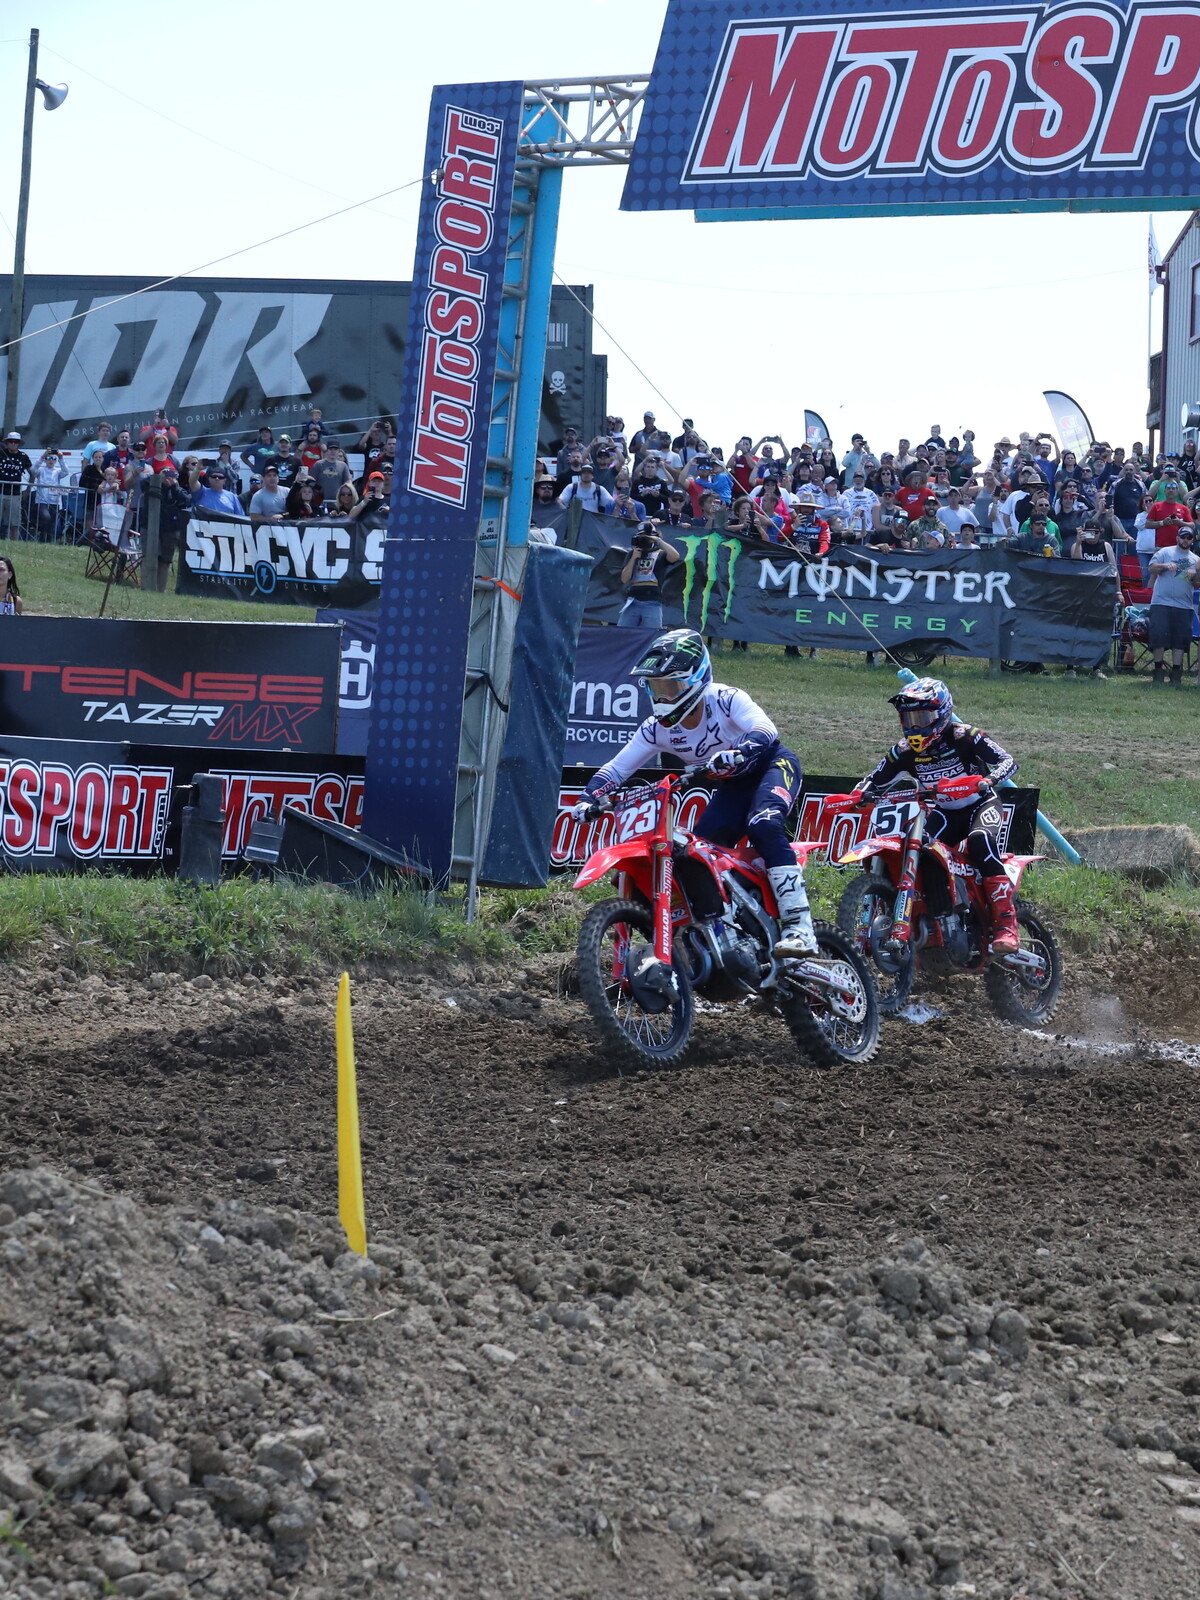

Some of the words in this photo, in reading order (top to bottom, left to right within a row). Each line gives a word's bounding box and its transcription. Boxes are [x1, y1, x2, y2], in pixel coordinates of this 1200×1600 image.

[186, 409, 244, 424] ORIGINAL
[250, 402, 315, 416] RACEWEAR
[185, 519, 351, 580] STACYC
[199, 575, 248, 586] STABILITY
[284, 583, 328, 593] CYCLE
[758, 557, 1017, 610] MONSTER
[796, 609, 979, 634] ENERGY
[82, 701, 225, 727] TAZER
[208, 704, 320, 743] MX
[918, 761, 965, 782] GASGAS
[618, 799, 662, 844] 23
[876, 803, 911, 836] 51
[898, 889, 907, 921] DUNLOP
[662, 908, 670, 957] DUNLOP
